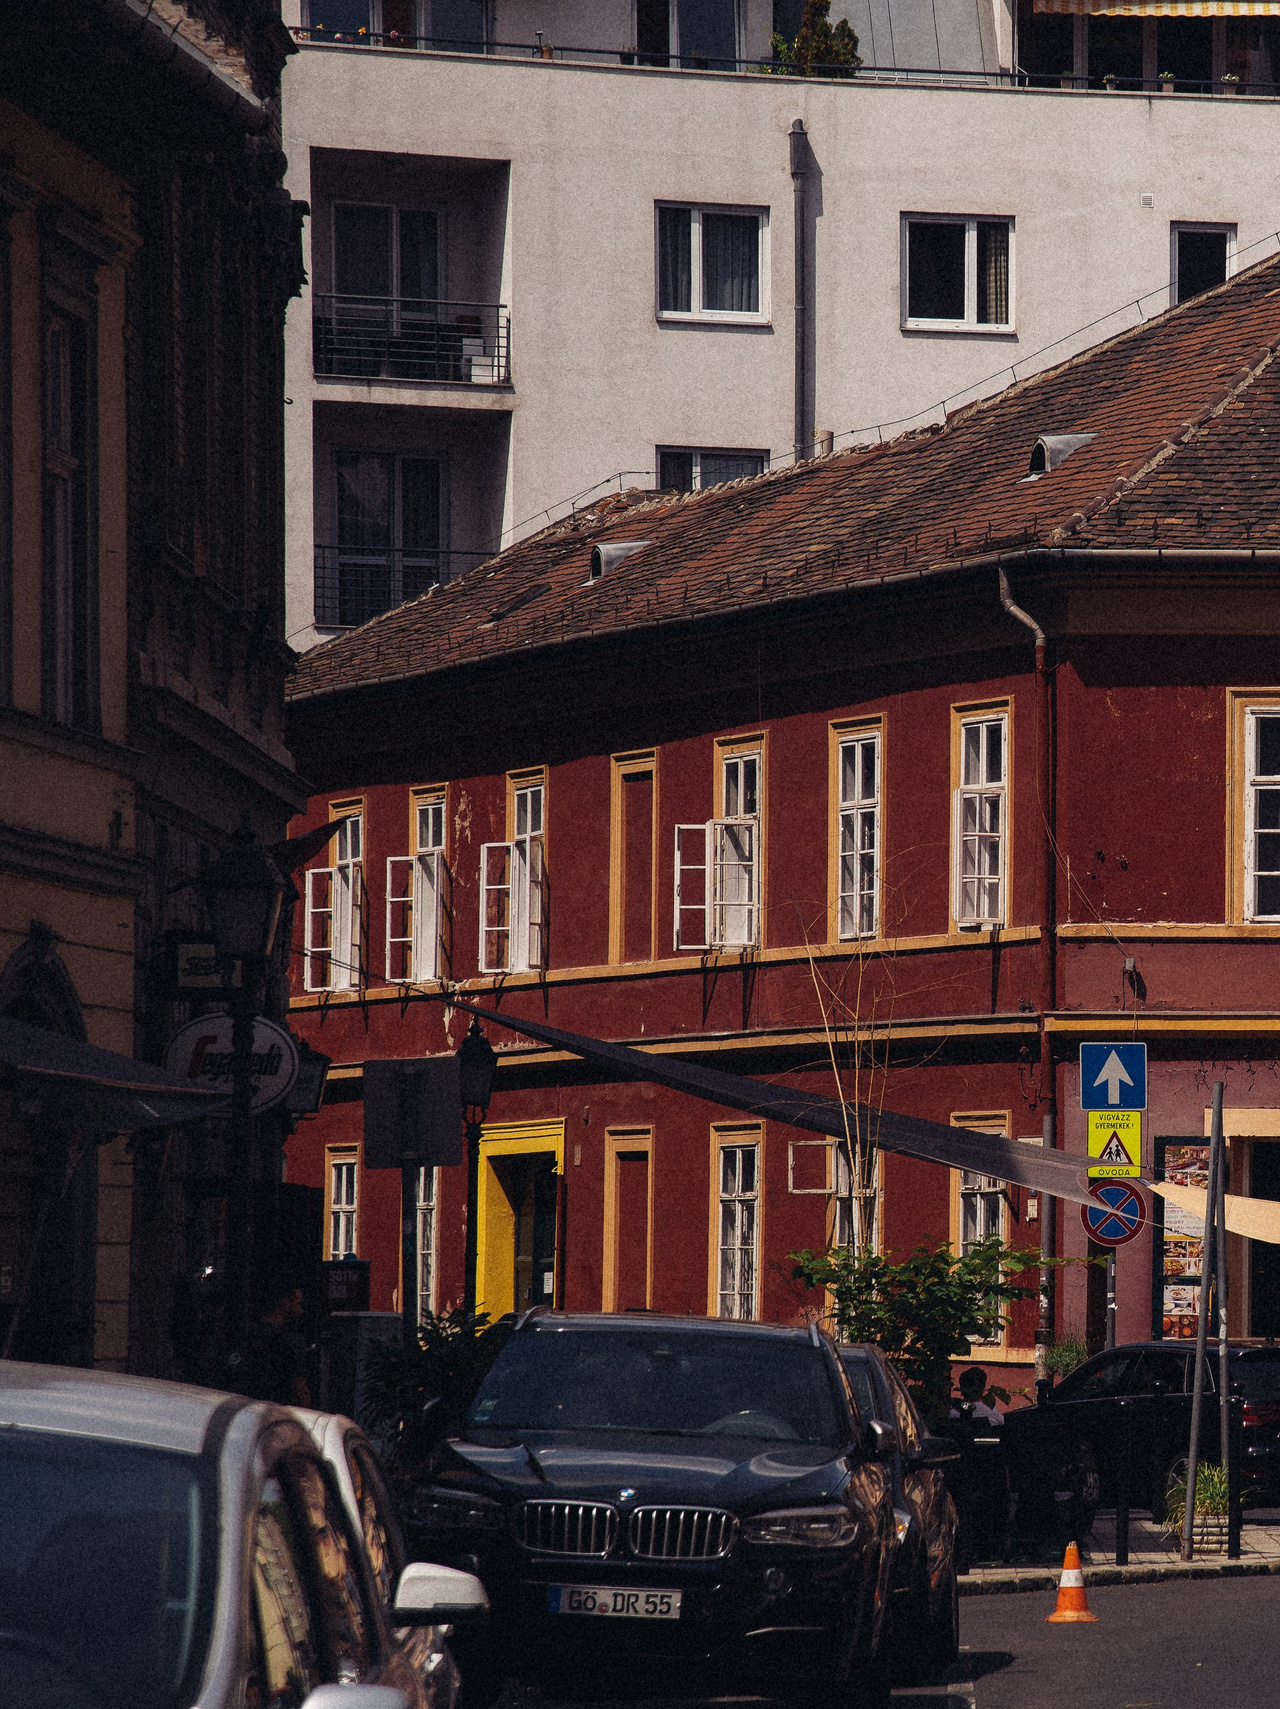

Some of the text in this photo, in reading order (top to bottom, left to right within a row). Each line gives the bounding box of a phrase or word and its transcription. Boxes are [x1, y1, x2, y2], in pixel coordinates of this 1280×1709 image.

[1099, 1113, 1131, 1121] VIGYÁZZ
[1098, 1167, 1131, 1176] ÓVODA
[568, 1589, 673, 1615] GÖ DR 55
